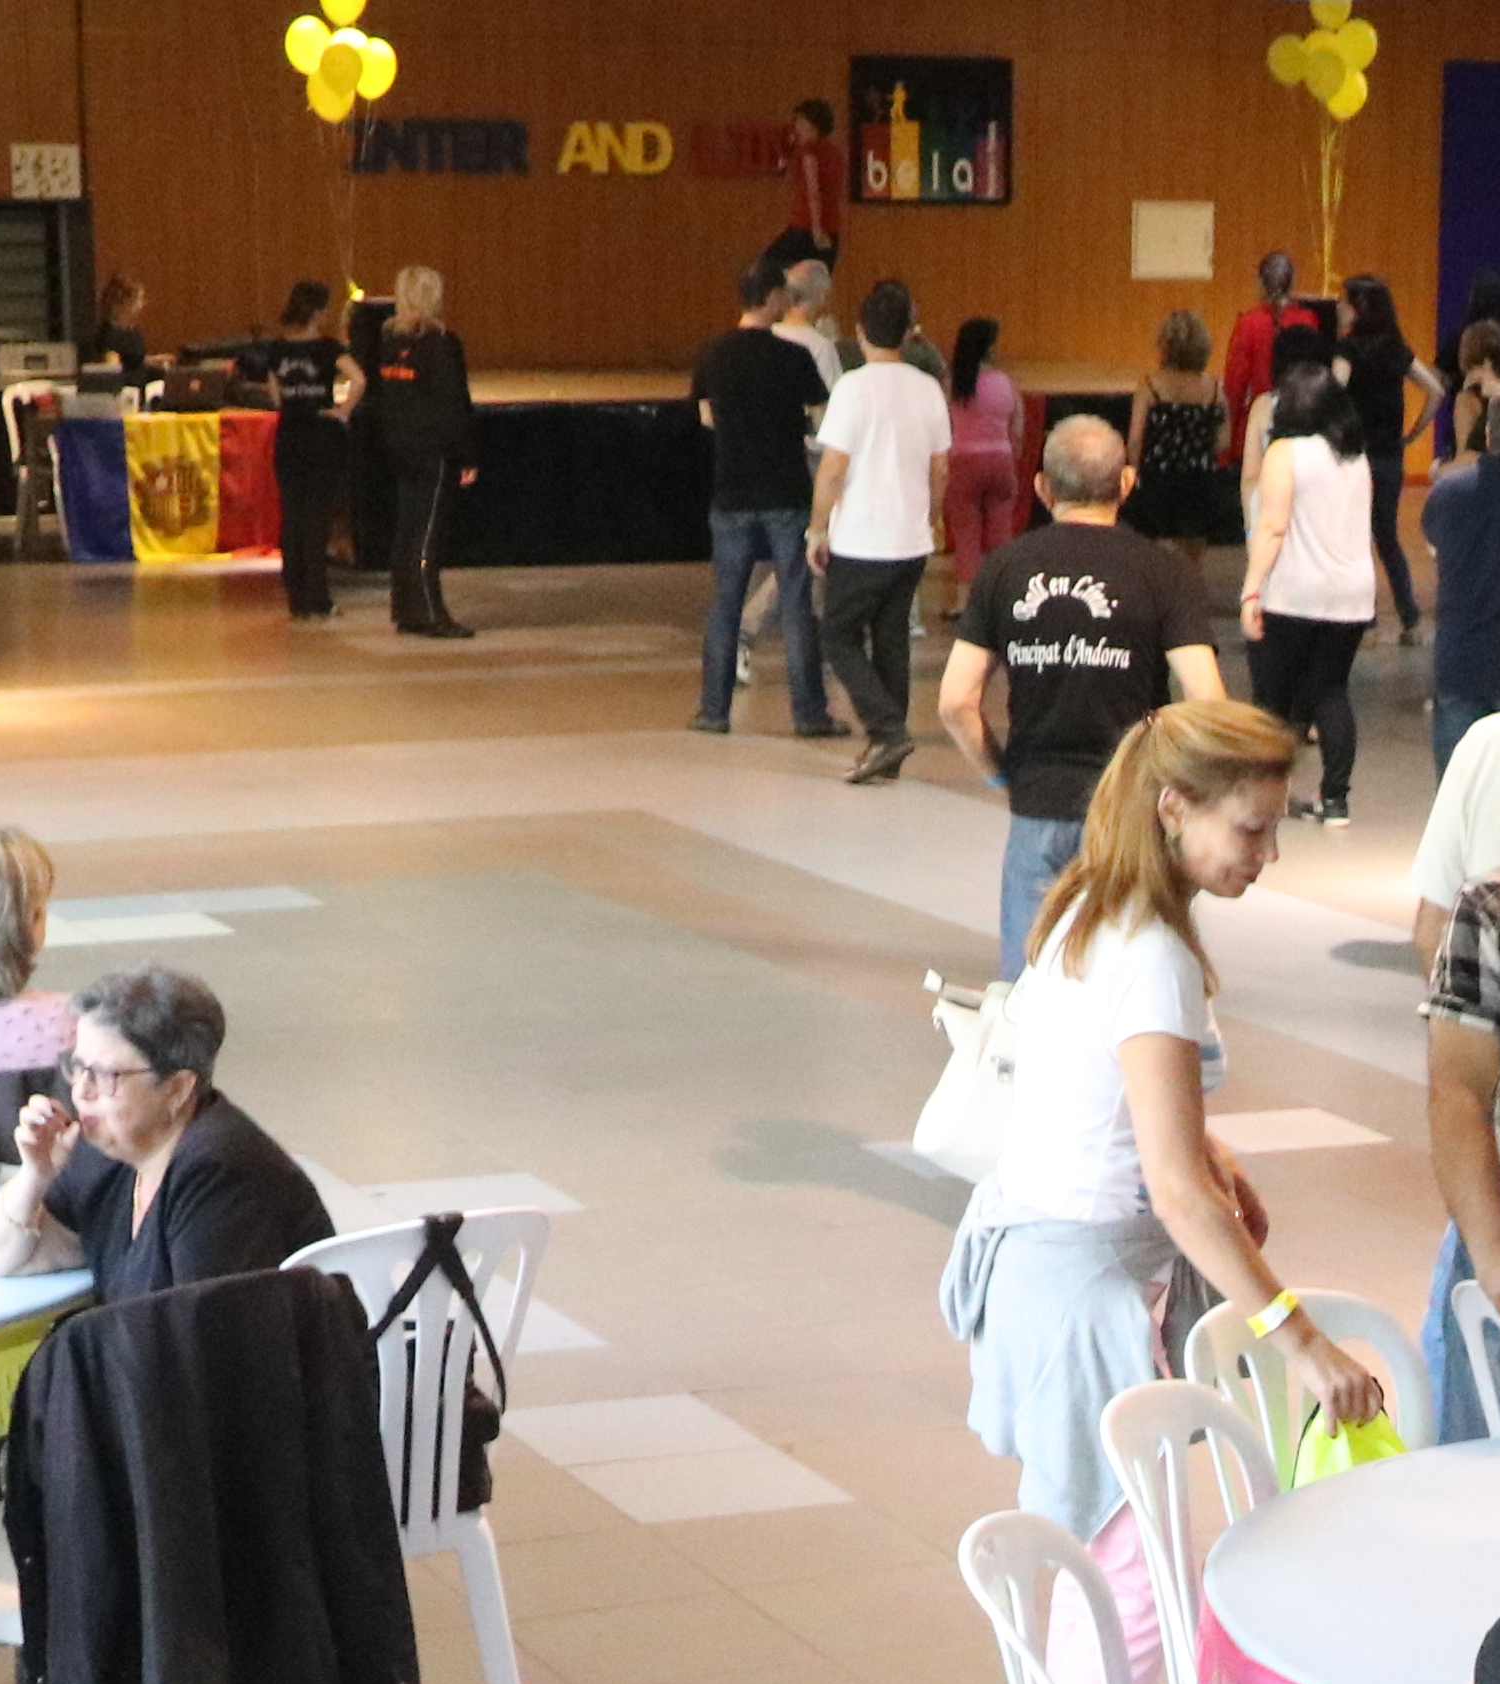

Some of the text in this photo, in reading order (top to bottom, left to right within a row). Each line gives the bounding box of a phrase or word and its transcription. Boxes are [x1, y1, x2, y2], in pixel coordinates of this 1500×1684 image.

[557, 119, 675, 175] AND
[1049, 576, 1071, 597] en
[1063, 634, 1131, 670] d'Andorra
